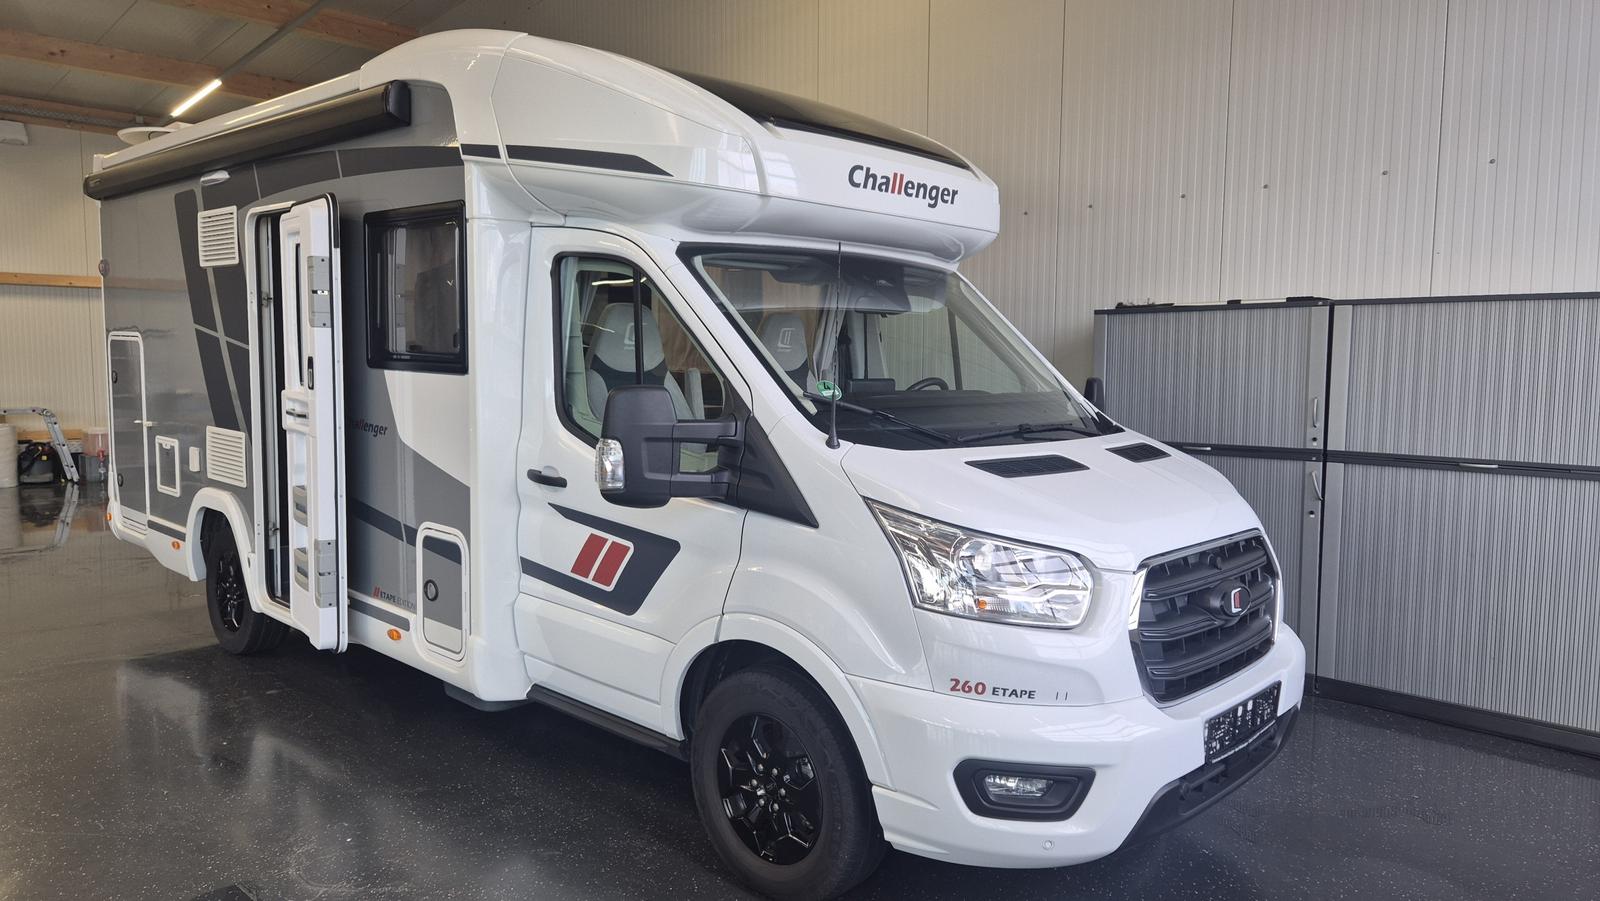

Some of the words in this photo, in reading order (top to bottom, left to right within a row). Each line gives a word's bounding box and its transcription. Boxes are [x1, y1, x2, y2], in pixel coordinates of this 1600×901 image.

[848, 164, 959, 209] Challenger
[949, 678, 987, 696] 260
[991, 686, 1037, 700] ETAPE
